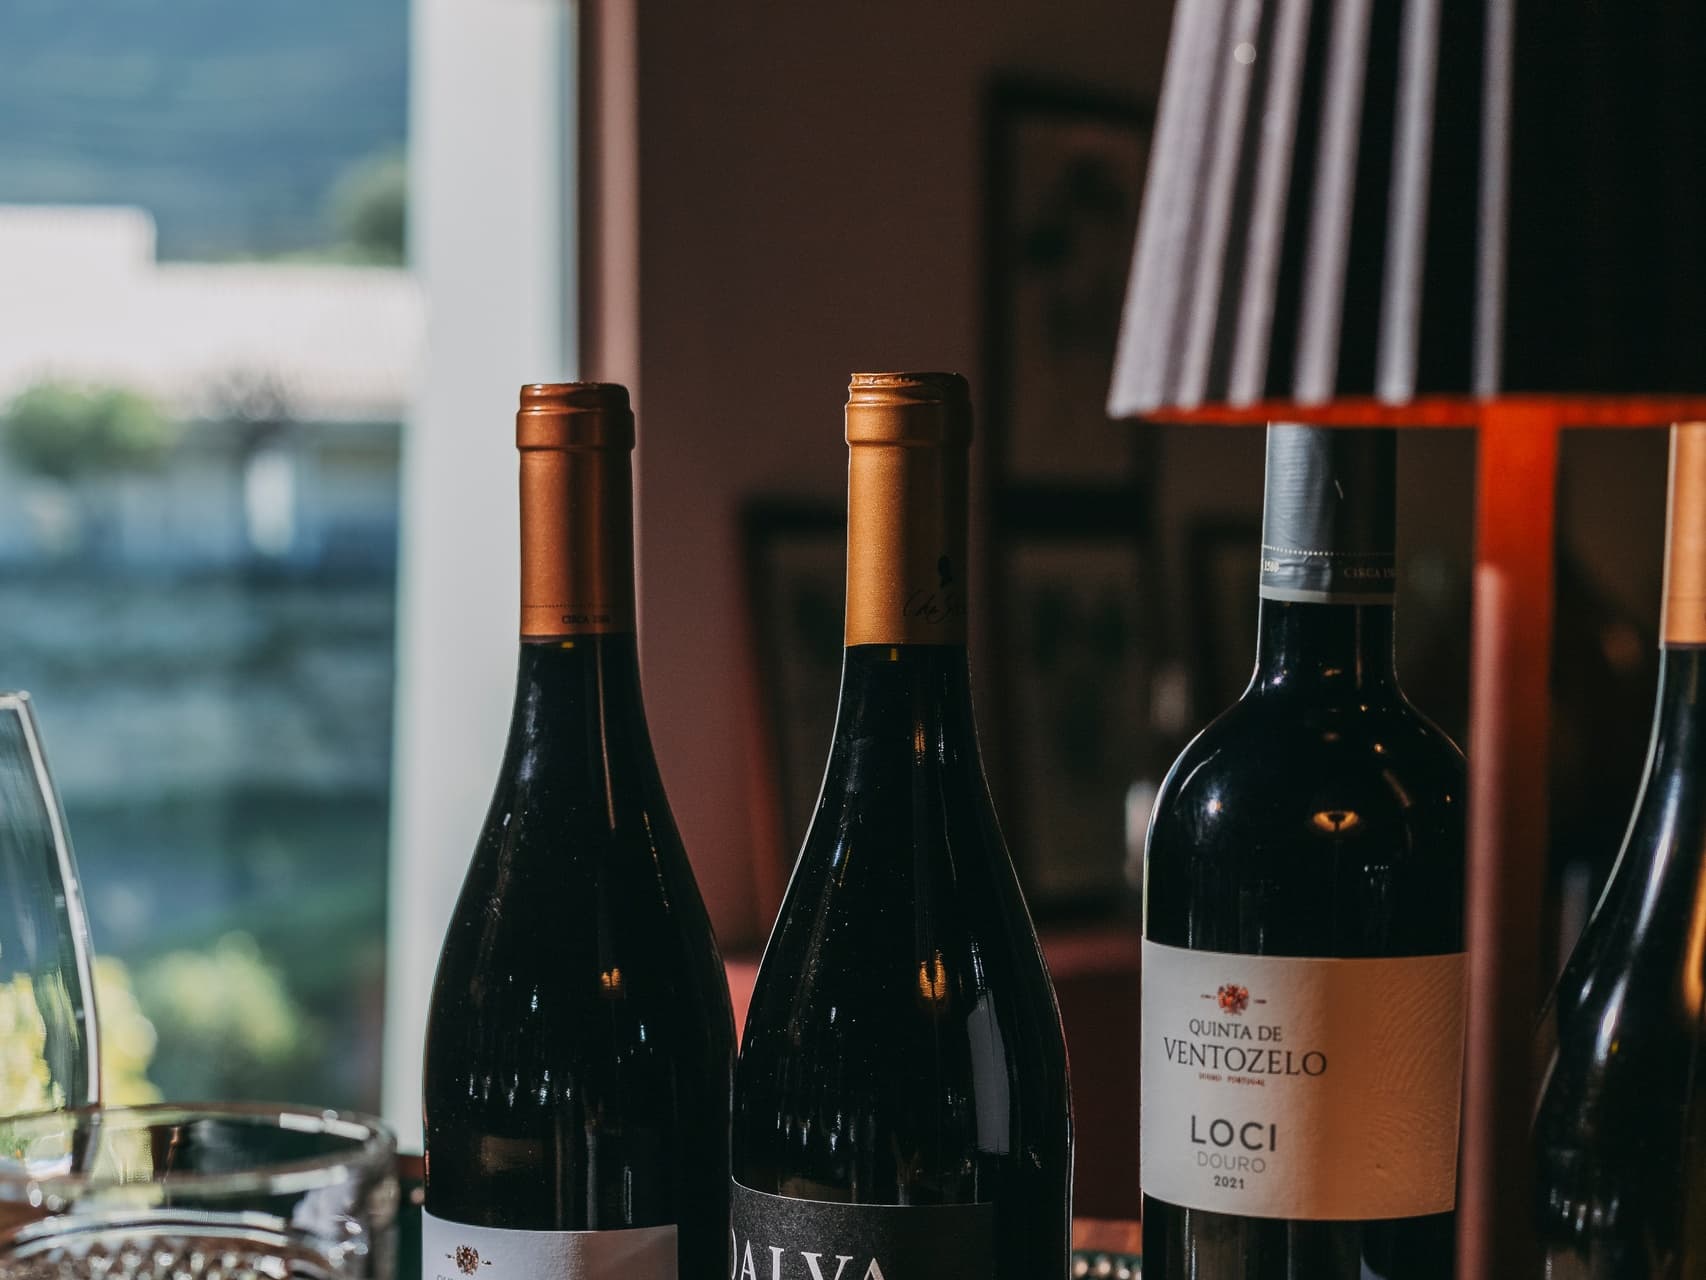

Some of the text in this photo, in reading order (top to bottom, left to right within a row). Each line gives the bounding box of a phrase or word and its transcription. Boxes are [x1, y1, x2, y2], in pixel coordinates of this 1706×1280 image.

[1189, 1018, 1283, 1042] QUINTA DE
[1163, 1036, 1328, 1077] VENTOZELO
[1191, 1114, 1276, 1152] LOCI
[1197, 1151, 1266, 1174] DOURO
[1213, 1175, 1245, 1190] 2021
